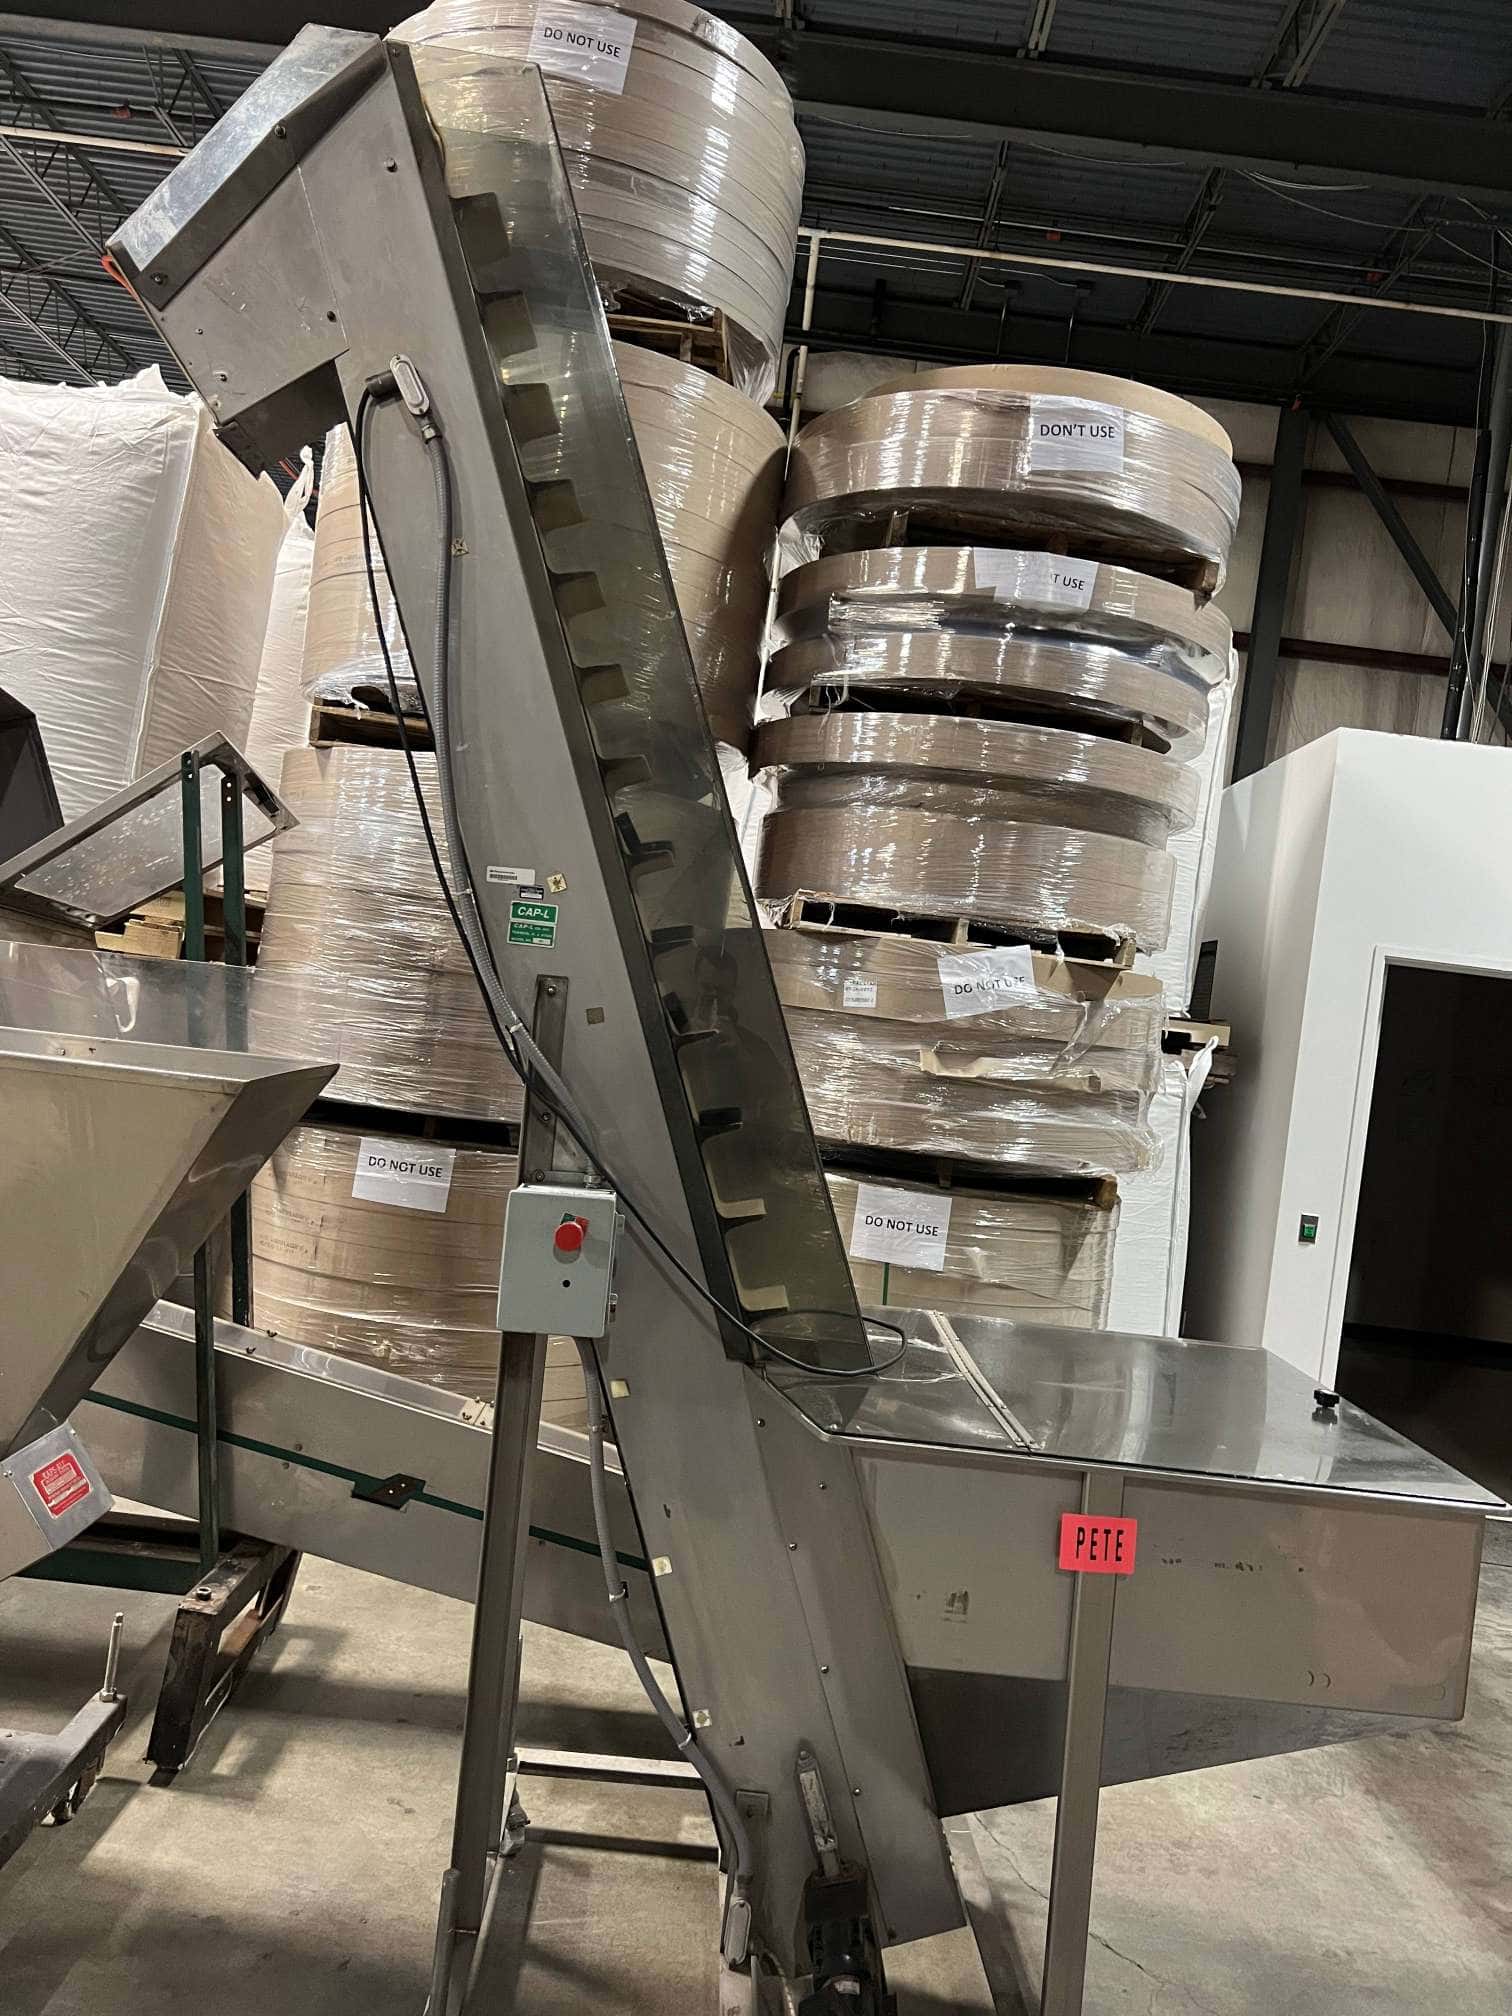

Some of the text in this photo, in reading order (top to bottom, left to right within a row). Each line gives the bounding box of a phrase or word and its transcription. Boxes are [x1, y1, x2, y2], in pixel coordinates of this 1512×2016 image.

[544, 27, 621, 58] DO NOT USE
[1040, 424, 1115, 439] DON'T USE
[1063, 575, 1085, 591] USE
[517, 906, 550, 919] CAP-L
[954, 983, 973, 995] DO
[368, 1156, 443, 1178] DO NOT USE
[865, 1215, 939, 1237] DO NOT USE
[1076, 1526, 1124, 1562] PETE
